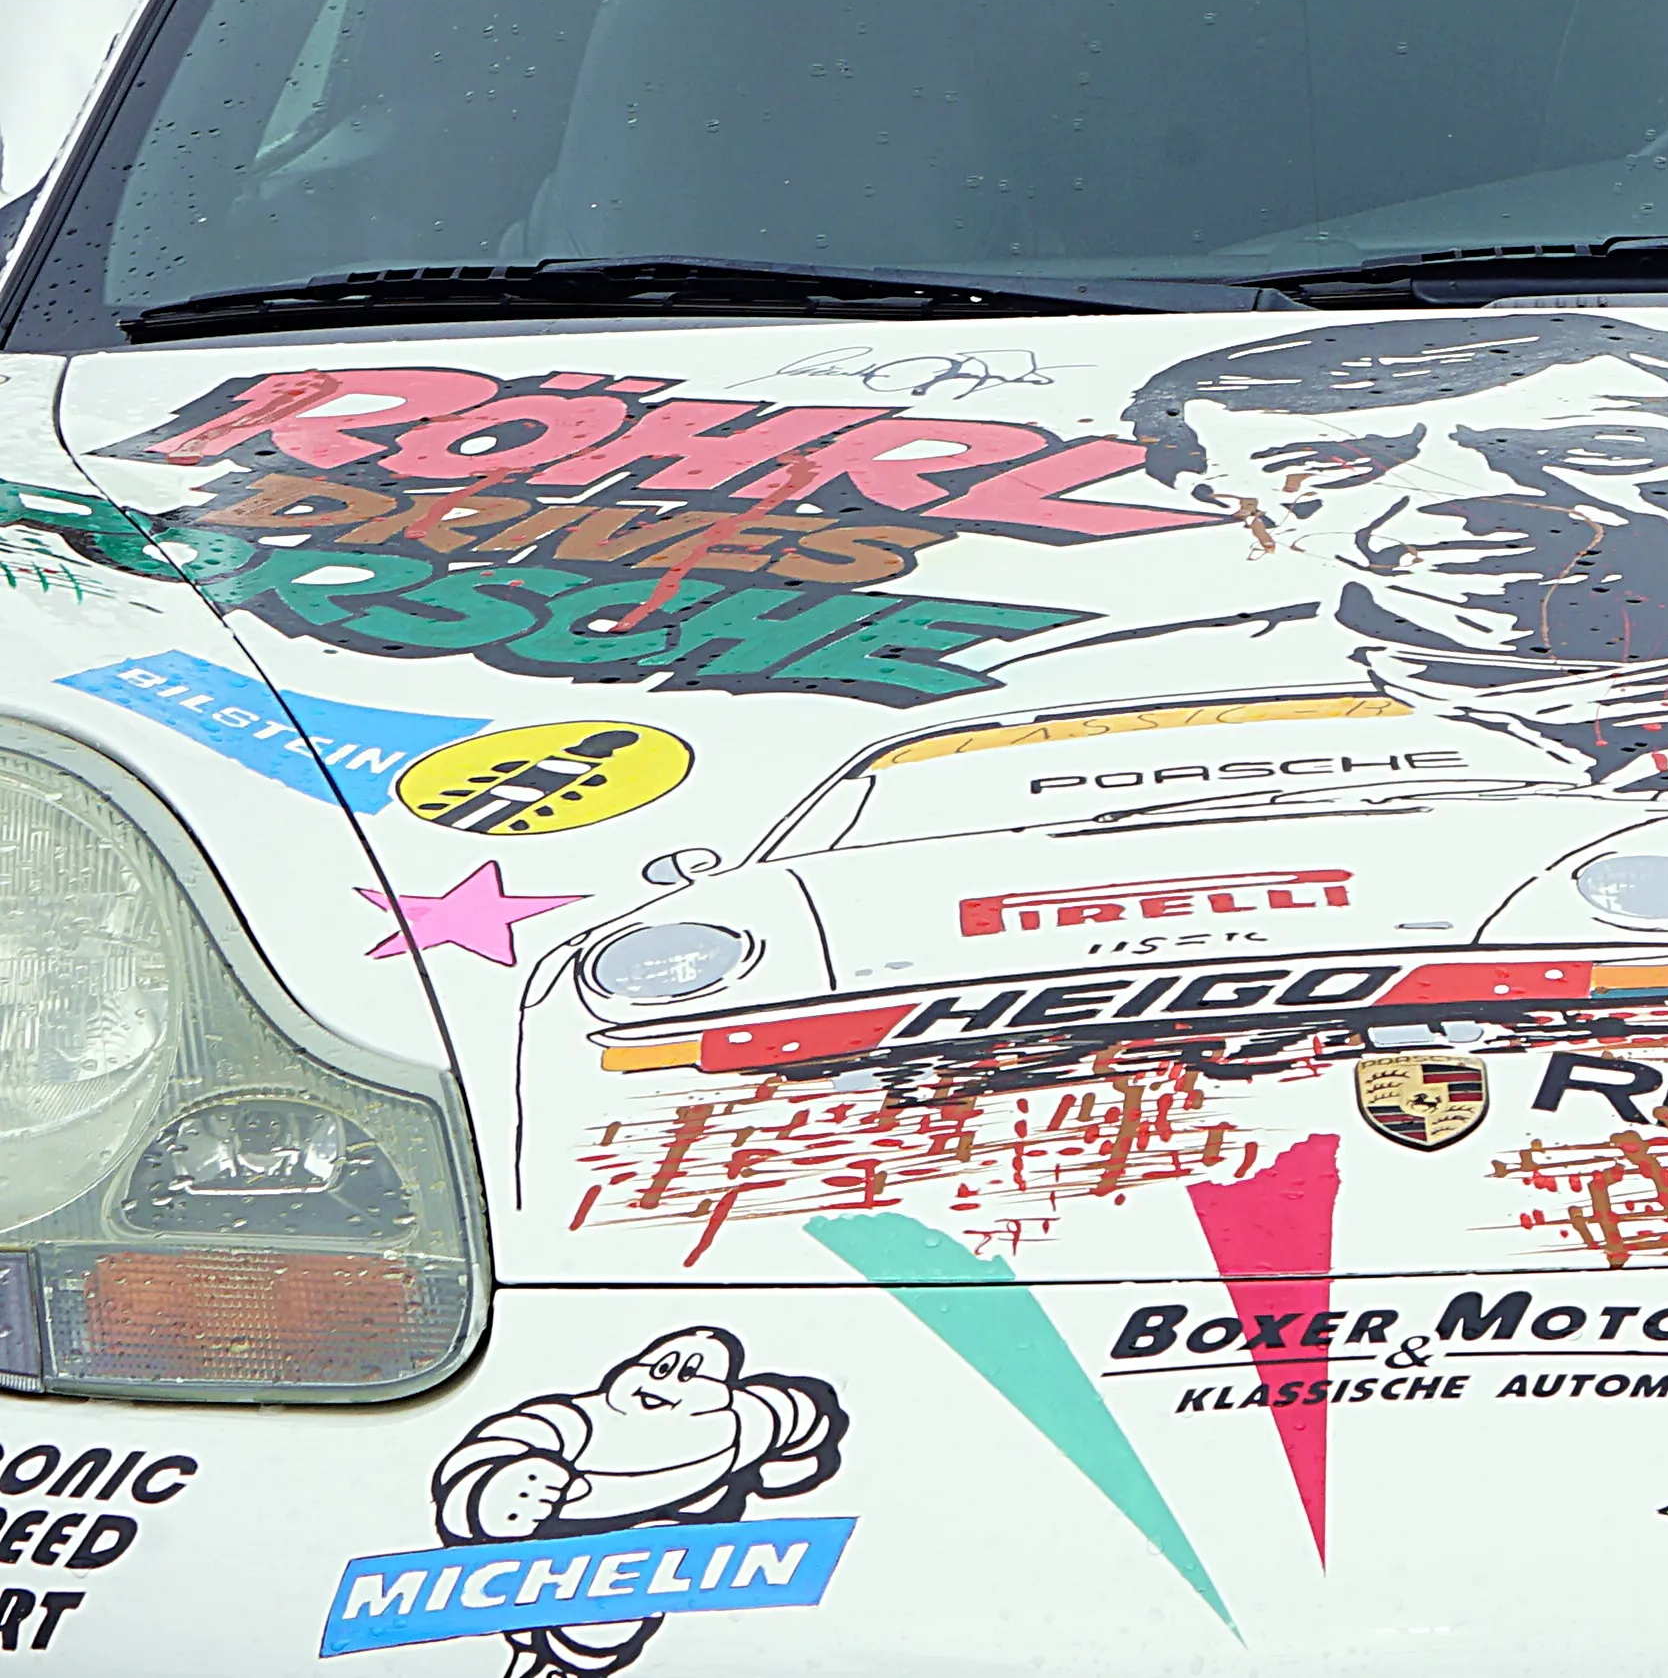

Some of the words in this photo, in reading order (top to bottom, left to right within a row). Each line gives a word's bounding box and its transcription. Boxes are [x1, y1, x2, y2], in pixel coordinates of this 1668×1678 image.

[148, 366, 1210, 538] RÖHRL
[200, 472, 955, 584] DRIVES
[117, 668, 405, 775] BILSTEIN
[1029, 750, 1471, 796] PORSCHE
[960, 869, 1353, 937] PIRELLI
[902, 964, 1403, 1039] HEIGO
[1109, 1304, 1399, 1359] BOXER
[1384, 1334, 1435, 1370] &
[1174, 1375, 1471, 1414] KLASSISCHE
[0, 1442, 199, 1505] ONIC
[0, 1507, 139, 1570] EED
[342, 1540, 812, 1622] MICHELIN
